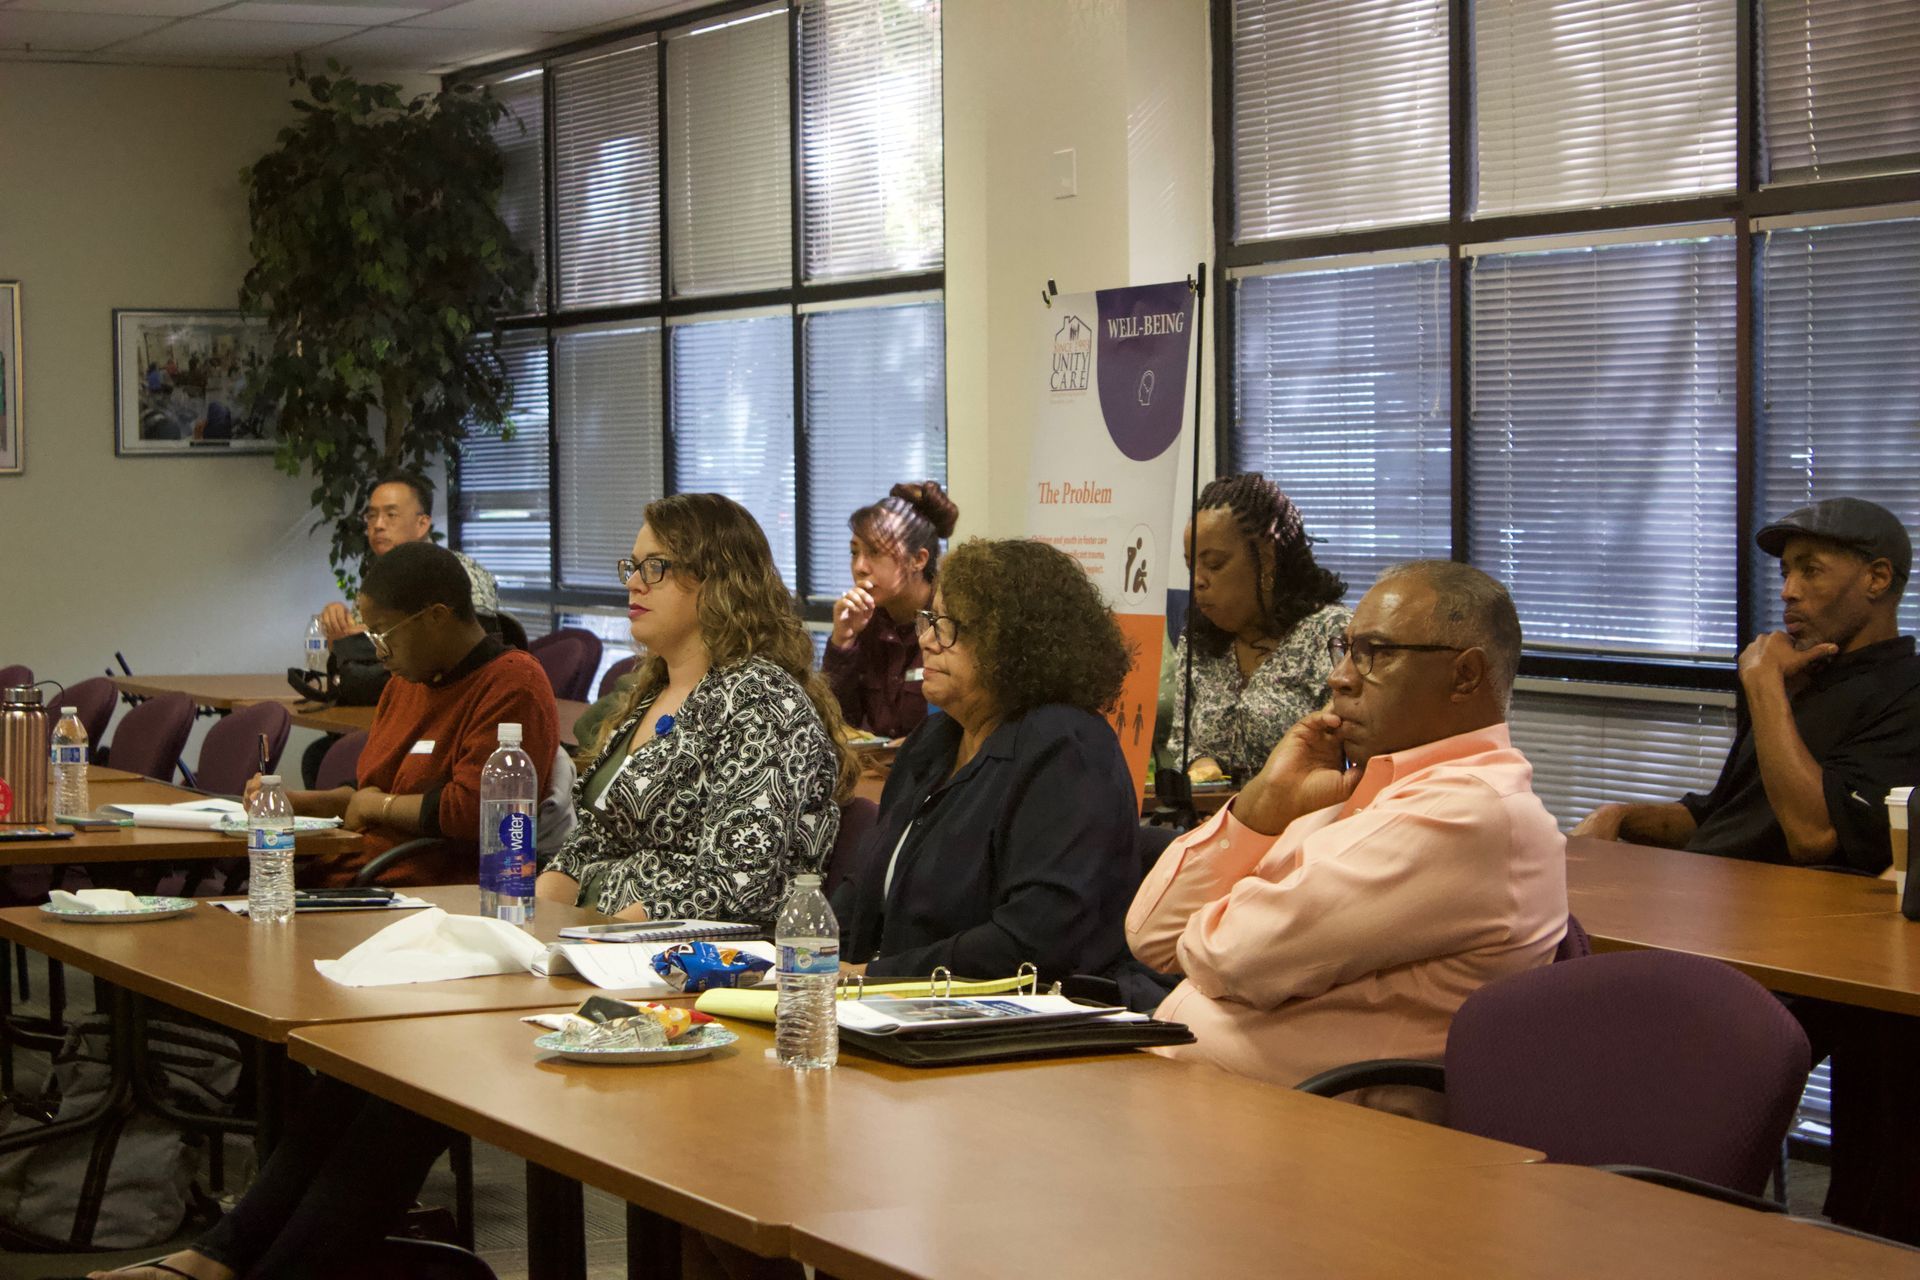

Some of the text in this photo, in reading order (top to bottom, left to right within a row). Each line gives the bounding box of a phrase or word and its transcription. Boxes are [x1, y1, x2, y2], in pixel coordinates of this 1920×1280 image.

[1107, 312, 1185, 339] WELL-BEING
[1052, 352, 1089, 371] UNITY
[1050, 370, 1086, 389] CARE
[1038, 481, 1112, 504] The Problem
[508, 814, 524, 851] water
